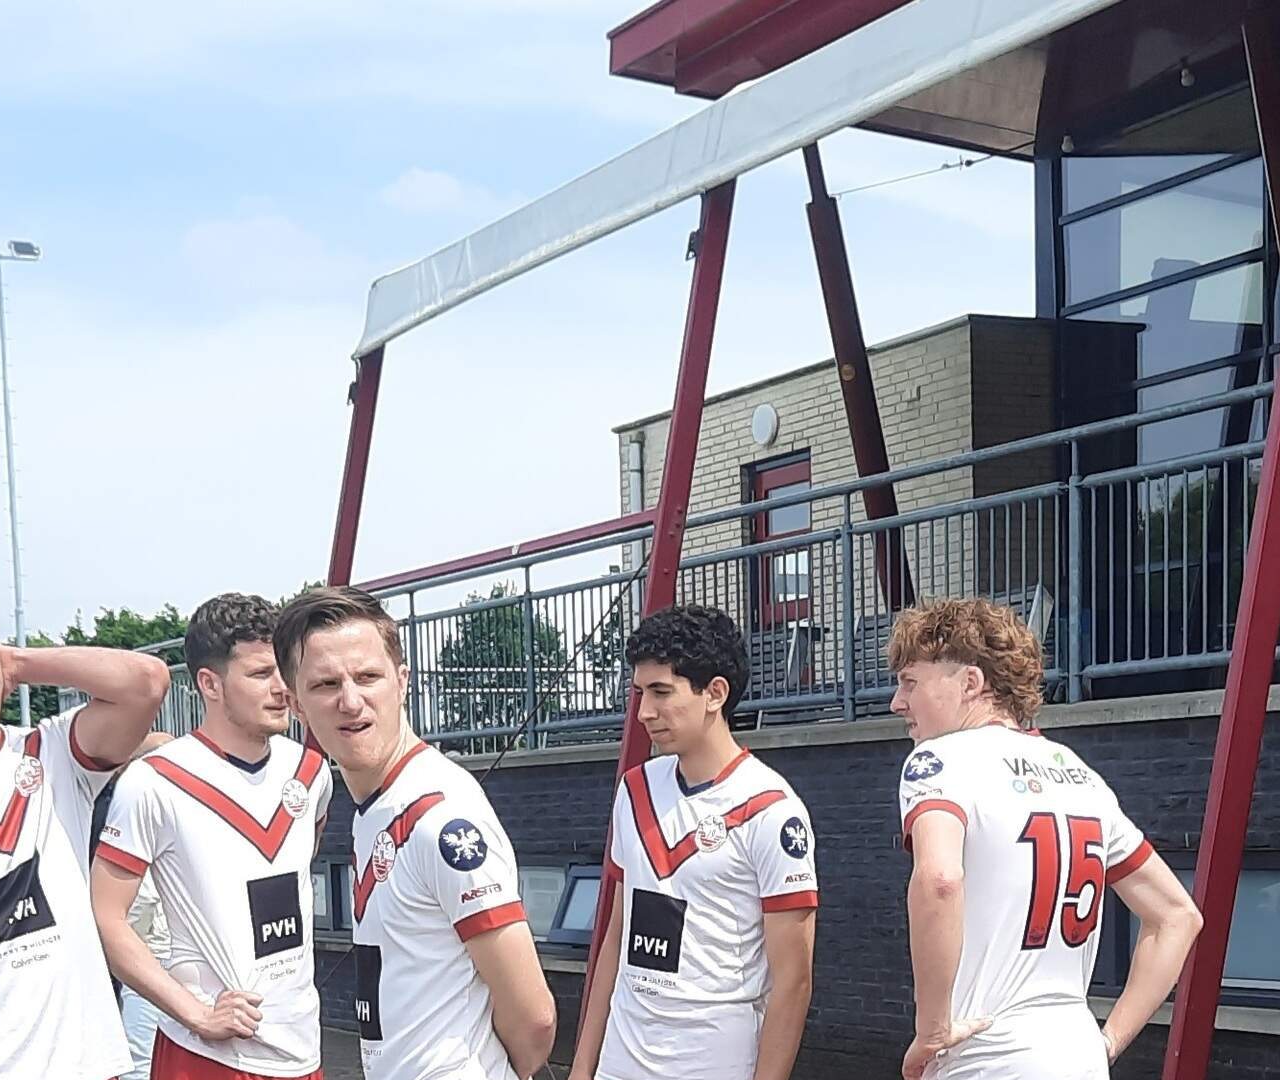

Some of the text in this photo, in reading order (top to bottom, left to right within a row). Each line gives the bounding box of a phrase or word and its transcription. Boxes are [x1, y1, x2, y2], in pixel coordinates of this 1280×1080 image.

[1003, 757, 1093, 785] VAN DIEP
[1016, 811, 1105, 951] 15
[261, 916, 297, 943] PVH
[633, 934, 669, 958] PVH
[355, 997, 371, 1022] VH
